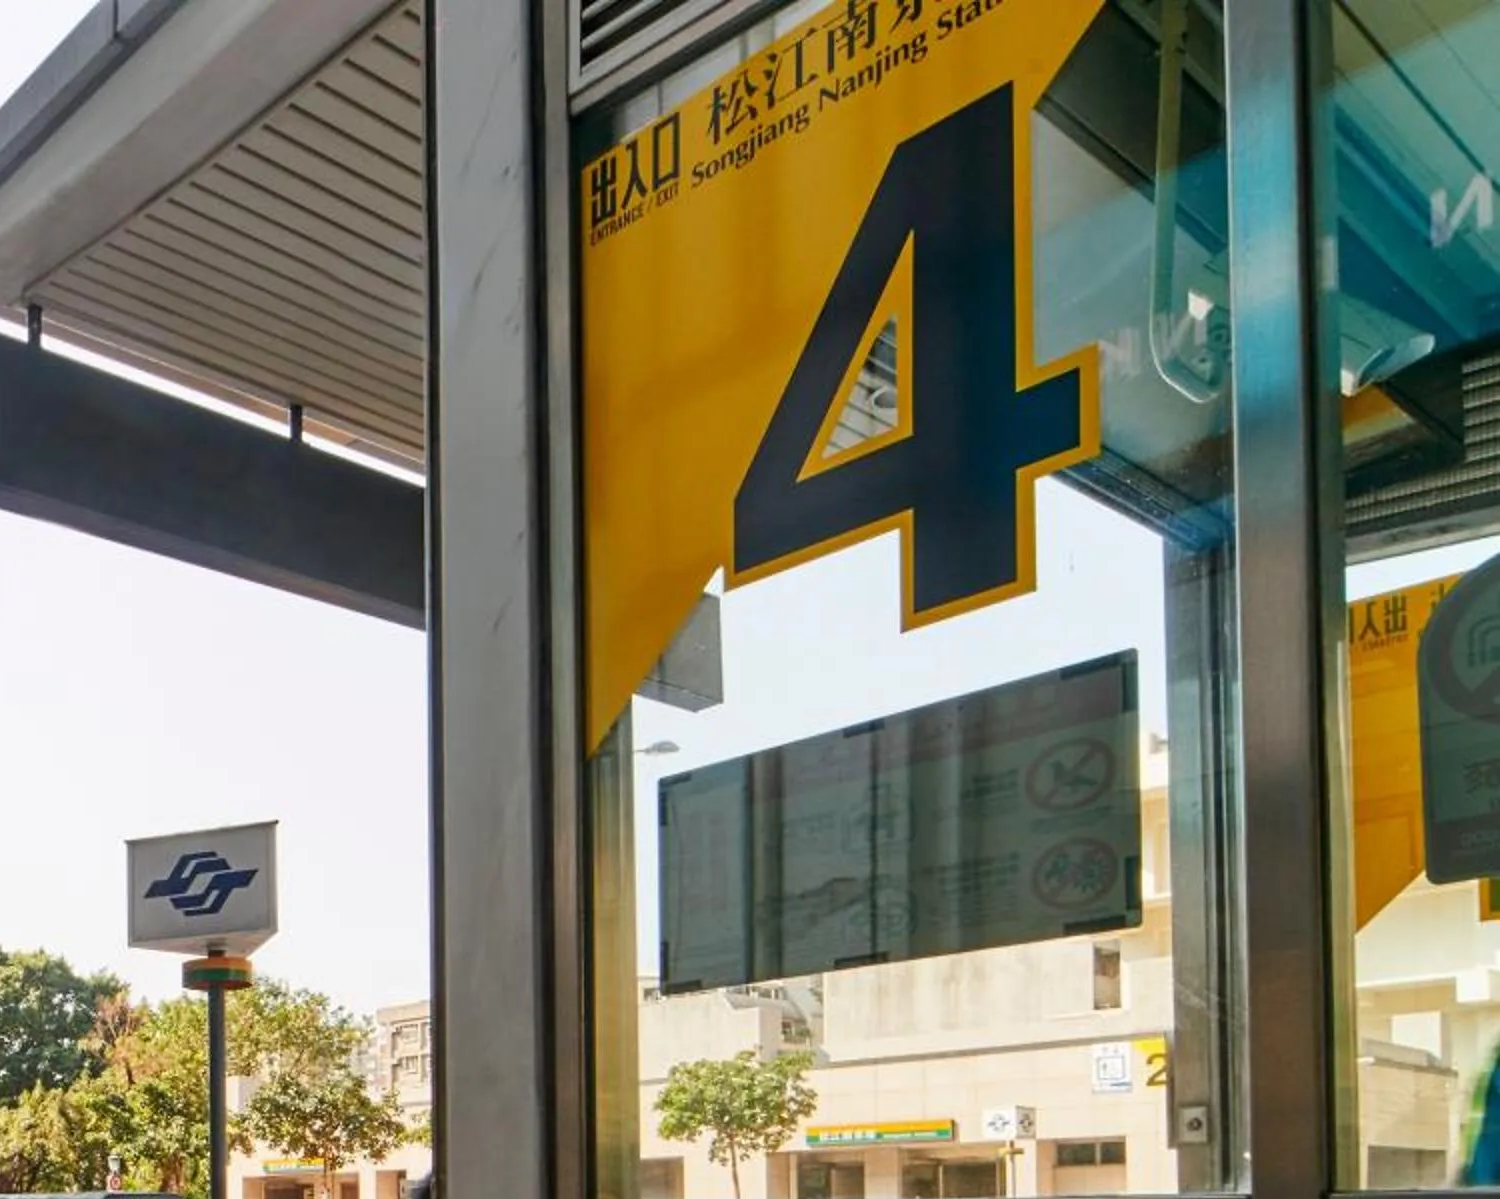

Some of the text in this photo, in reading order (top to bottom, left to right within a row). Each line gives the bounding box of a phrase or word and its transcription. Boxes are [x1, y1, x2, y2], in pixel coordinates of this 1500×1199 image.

[691, 103, 811, 189] Songjiang
[818, 32, 929, 113] Nanjing
[589, 203, 645, 247] ENTRANCE
[655, 182, 680, 207] EXIT
[590, 111, 681, 229] 出入口
[734, 80, 1081, 614] 4
[1146, 1053, 1169, 1087] 2
